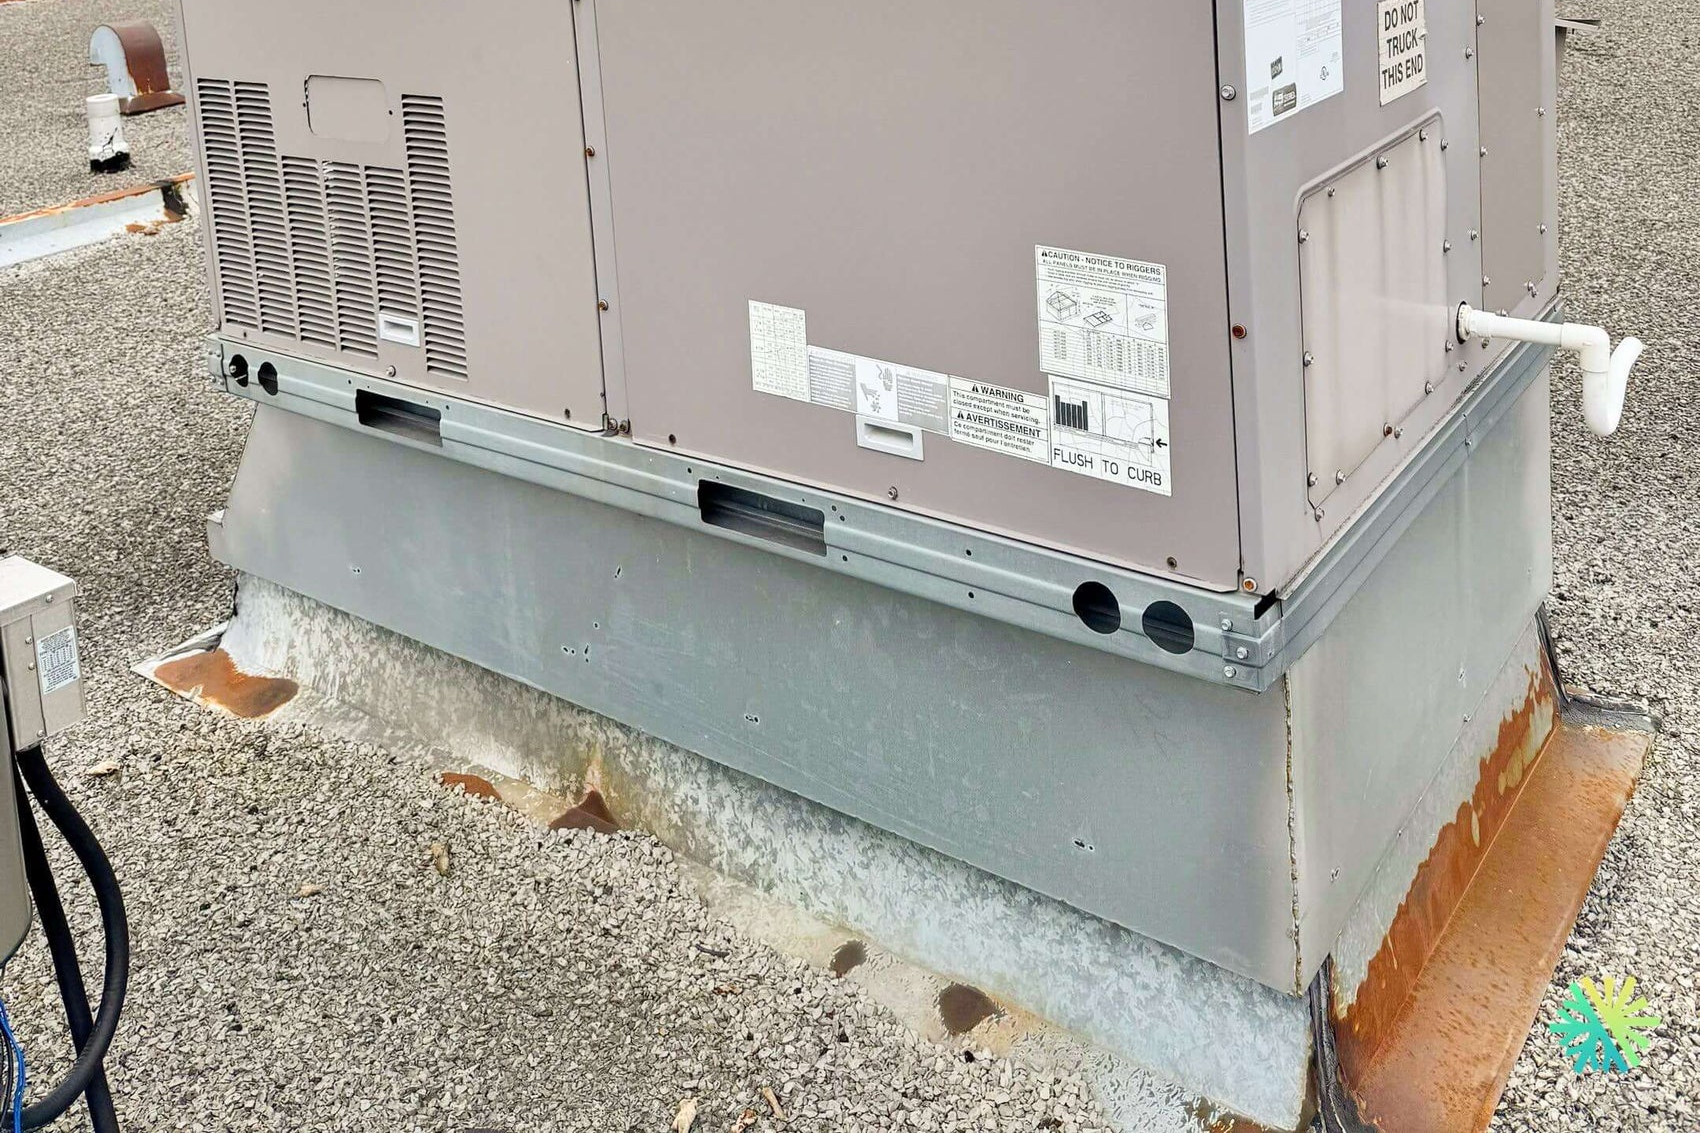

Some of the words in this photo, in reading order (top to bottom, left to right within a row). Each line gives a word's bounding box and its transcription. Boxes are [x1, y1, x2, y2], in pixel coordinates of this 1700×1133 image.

[1385, 8, 1398, 31] DO
[1401, 0, 1418, 25] NOT
[1387, 28, 1418, 58] TRUCK
[1382, 62, 1403, 89] THIS
[1405, 53, 1423, 79] END
[1048, 251, 1080, 262] CAUTION
[1086, 257, 1112, 267] NOTICE
[1114, 262, 1125, 270] TO
[1126, 264, 1161, 275] RIGGERS
[967, 394, 1005, 407] compartment
[1006, 403, 1021, 411] must
[981, 386, 1024, 403] WARNING
[953, 399, 972, 407] closed
[973, 403, 993, 413] except
[994, 408, 1010, 416] when
[1011, 413, 1041, 425] servicing.
[963, 423, 1003, 437] compartiment
[966, 413, 1041, 437] AVERTISSEMENT
[985, 437, 999, 445] pour
[1053, 448, 1094, 469] FLUSH
[1102, 459, 1119, 475] TO
[1127, 466, 1162, 486] CURB
